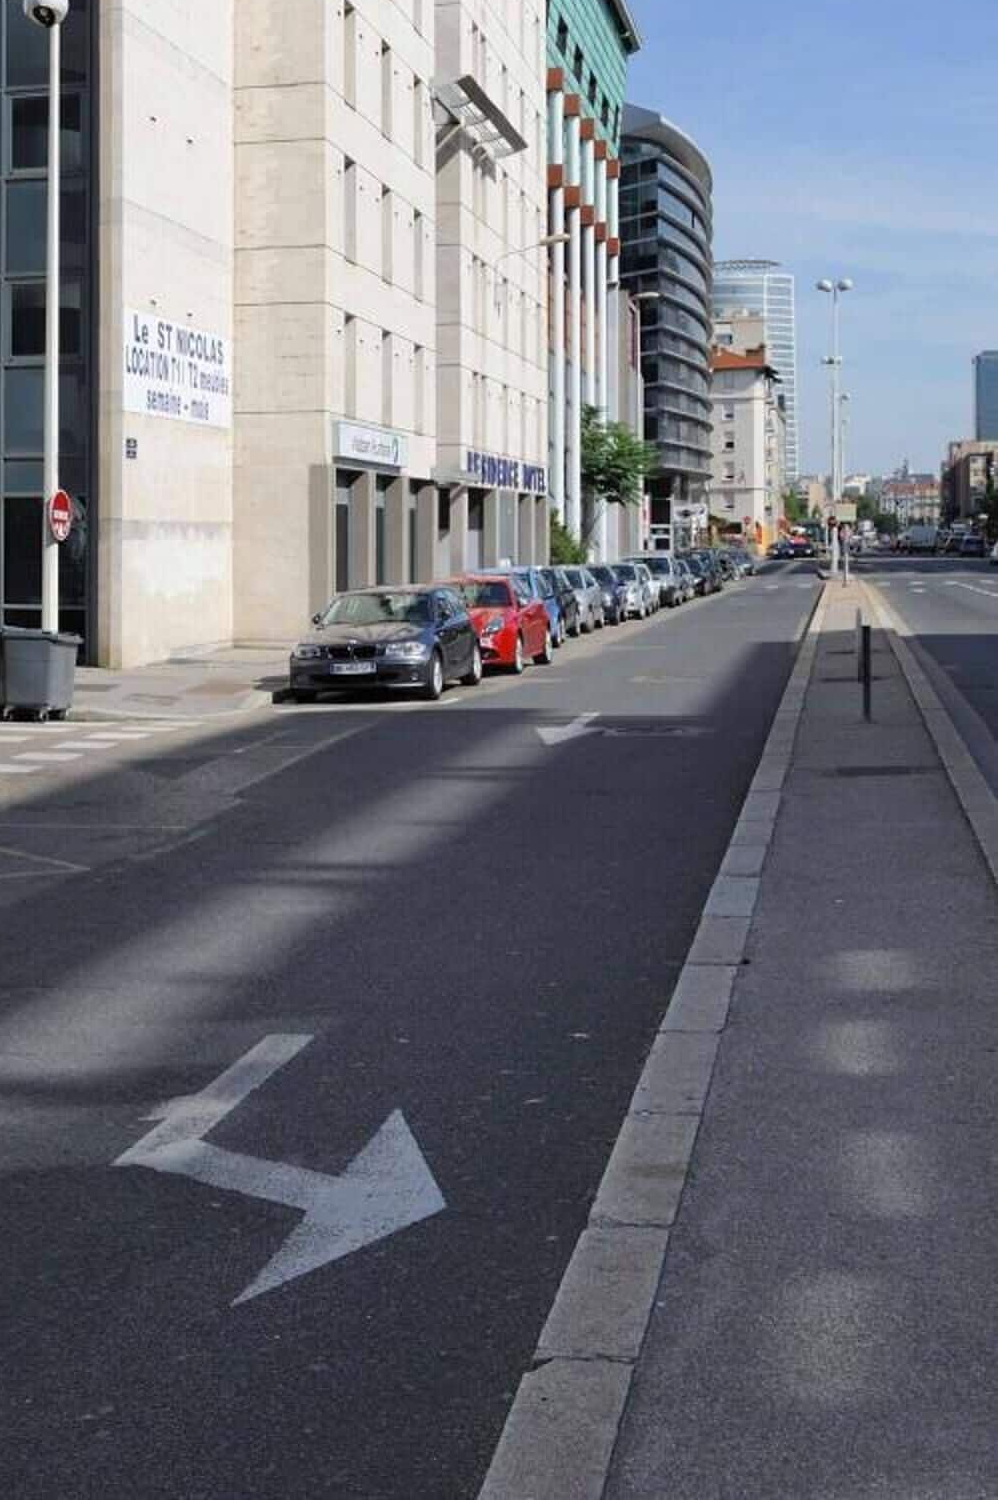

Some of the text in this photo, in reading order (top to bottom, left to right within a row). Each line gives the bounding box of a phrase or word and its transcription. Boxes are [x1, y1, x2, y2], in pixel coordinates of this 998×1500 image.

[133, 314, 224, 365] Le ST NICOLAS
[125, 345, 169, 381] LOCATION
